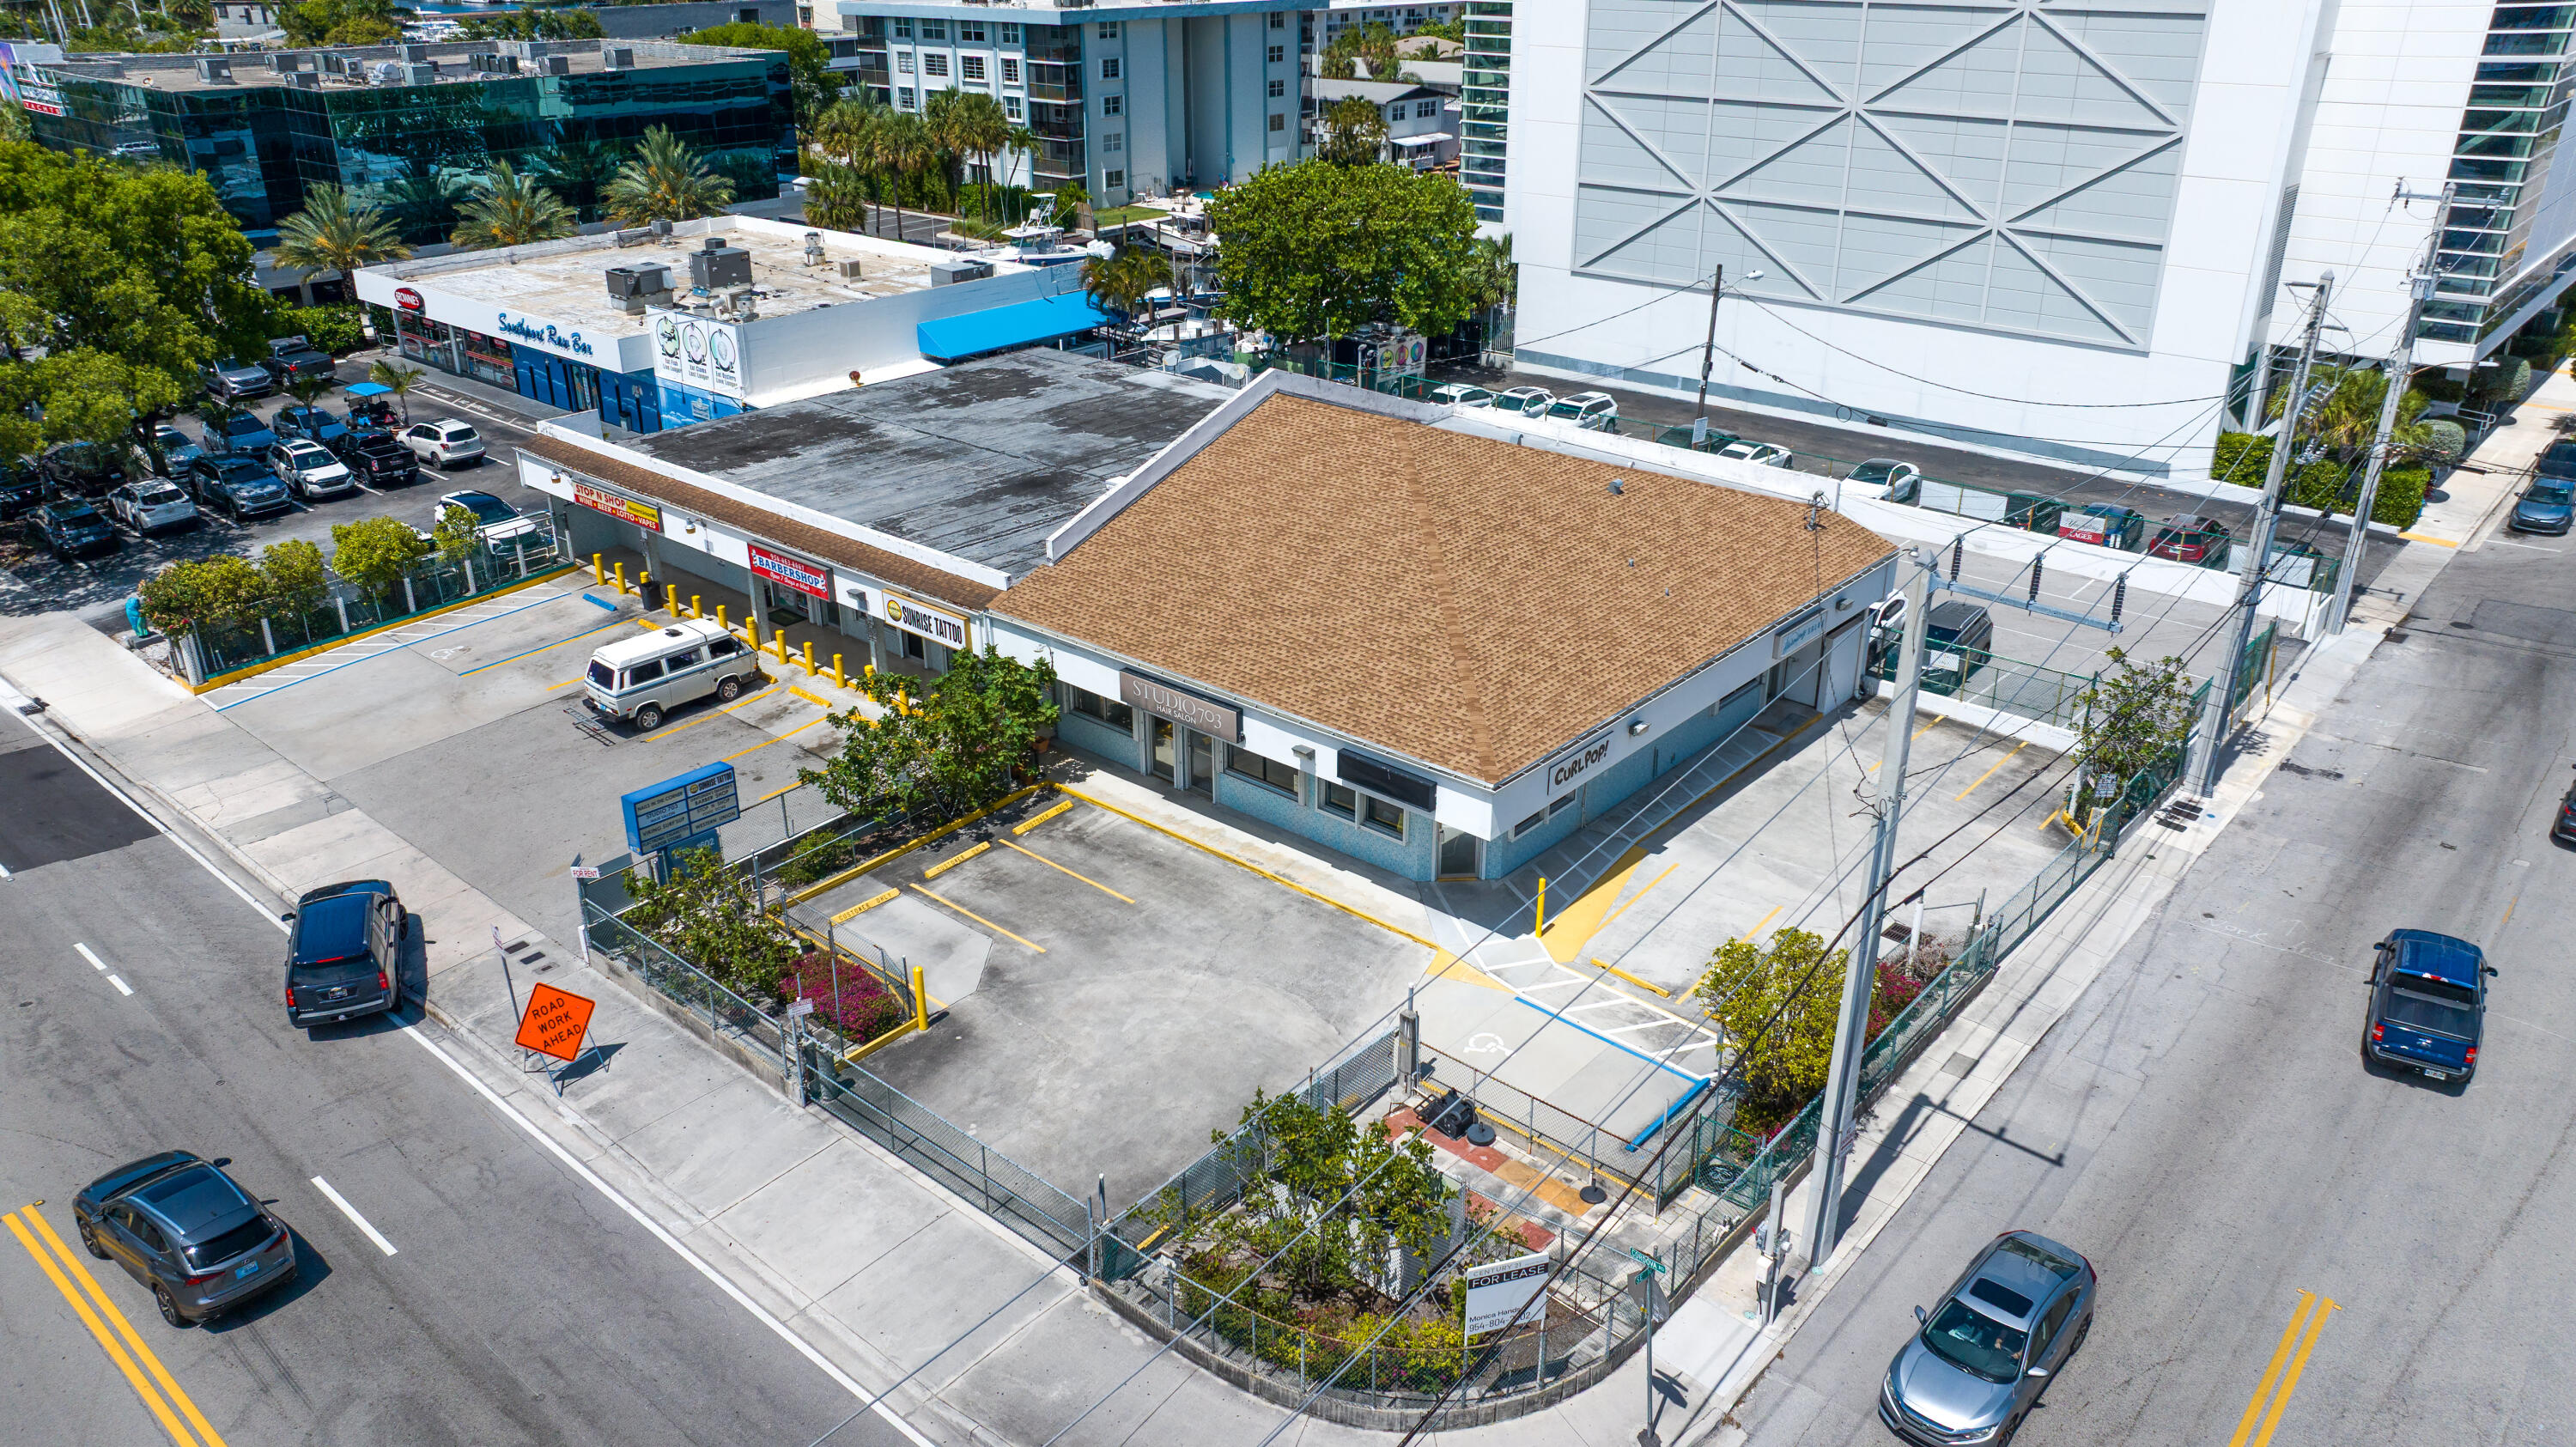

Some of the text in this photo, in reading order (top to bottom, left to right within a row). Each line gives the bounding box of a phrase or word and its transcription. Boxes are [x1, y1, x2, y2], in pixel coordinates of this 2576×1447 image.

[26, 102, 61, 115] YACHTS
[498, 313, 593, 356] Southport Raw Bar
[575, 484, 625, 508] STOP N SHOP
[578, 496, 656, 529] WINE BEER LOTTO VAPES
[2069, 531, 2093, 540] LAGER
[757, 556, 820, 587] BARBERSHOP
[784, 576, 795, 587] Days
[799, 582, 811, 591] Week
[902, 605, 962, 644] SUNRISE TATTOO
[1133, 679, 1222, 728] STUDIO 703
[1157, 704, 1196, 725] HAIR SALON
[1554, 739, 1609, 786] CURL POP!
[698, 772, 732, 791] SUNRISE TATTOO
[695, 790, 729, 806] BARBER SHOP
[697, 805, 709, 813] STOP
[717, 798, 730, 806] SHOP
[646, 807, 667, 819] STUDIO
[696, 811, 736, 830] WESTERN UNION
[1023, 803, 1069, 830] CUSTOMER ONLY
[642, 826, 662, 836] VIKING
[838, 892, 892, 921] CUSTOMER ONLY
[532, 997, 565, 1020] ROAD
[538, 1011, 573, 1034] WORK
[544, 1024, 581, 1050] AHEAD
[1631, 1249, 1657, 1268] CORDOVA
[1472, 1264, 1546, 1288] FOR LEASE
[1473, 1263, 1512, 1277] CENTURY
[1469, 1313, 1496, 1322] Monica
[1469, 1311, 1531, 1332] 954-804-02
